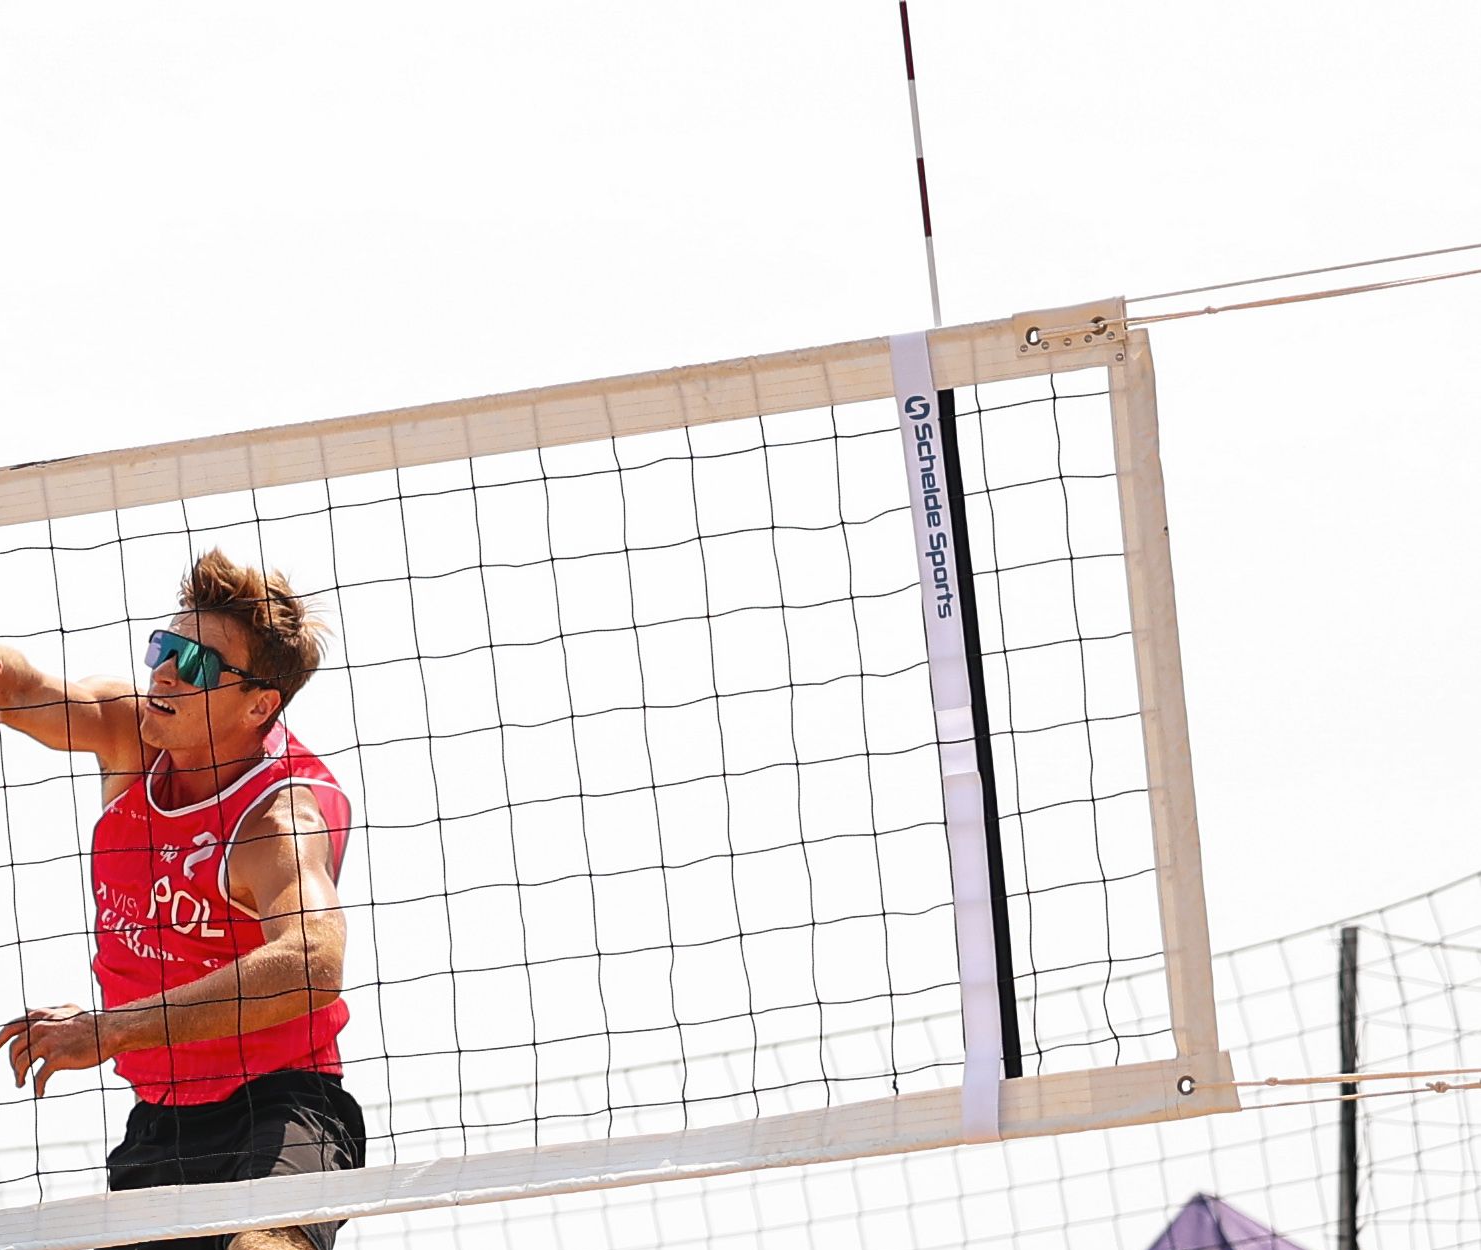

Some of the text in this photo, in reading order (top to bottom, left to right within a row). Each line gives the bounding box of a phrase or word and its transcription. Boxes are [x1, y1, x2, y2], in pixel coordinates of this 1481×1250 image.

[914, 422, 954, 619] Schelde Sports
[146, 875, 225, 938] POL
